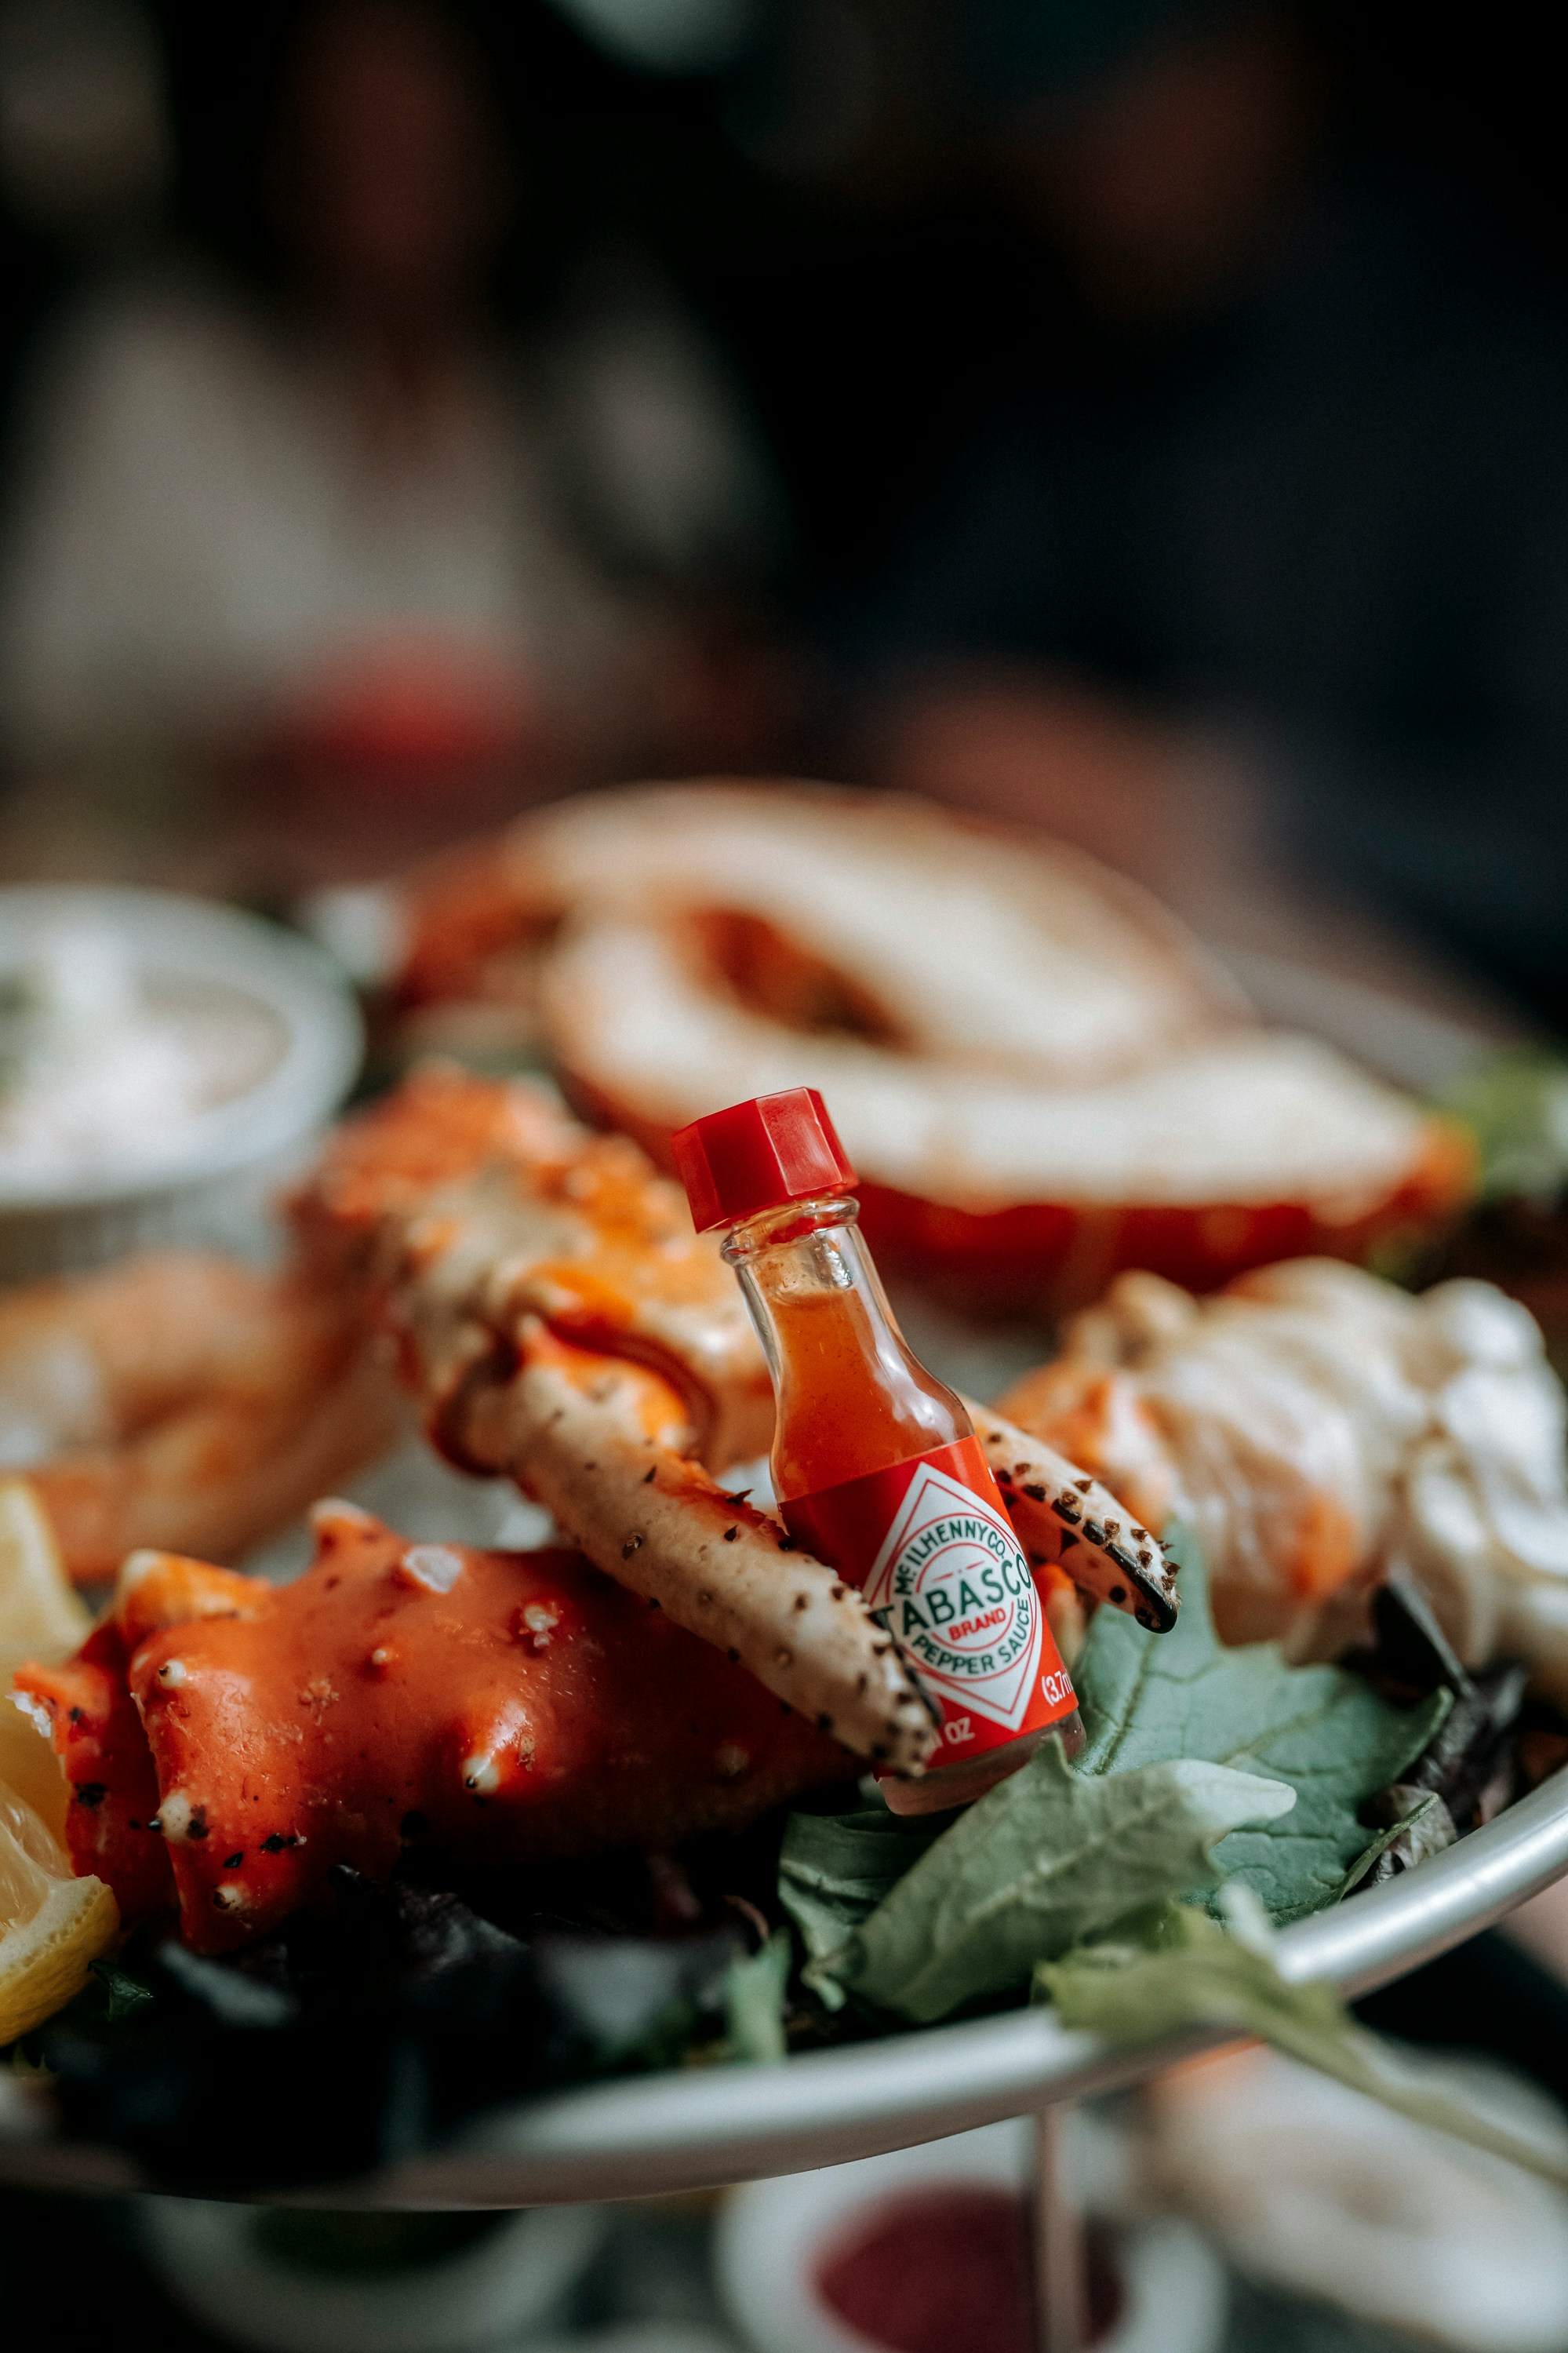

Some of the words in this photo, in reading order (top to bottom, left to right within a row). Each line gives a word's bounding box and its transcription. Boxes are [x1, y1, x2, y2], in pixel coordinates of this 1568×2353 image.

[911, 1634, 995, 1675] PEPPER
[999, 1597, 1030, 1663] SAUCE
[948, 1607, 1006, 1641] BRAND
[944, 1716, 976, 1746] OZ
